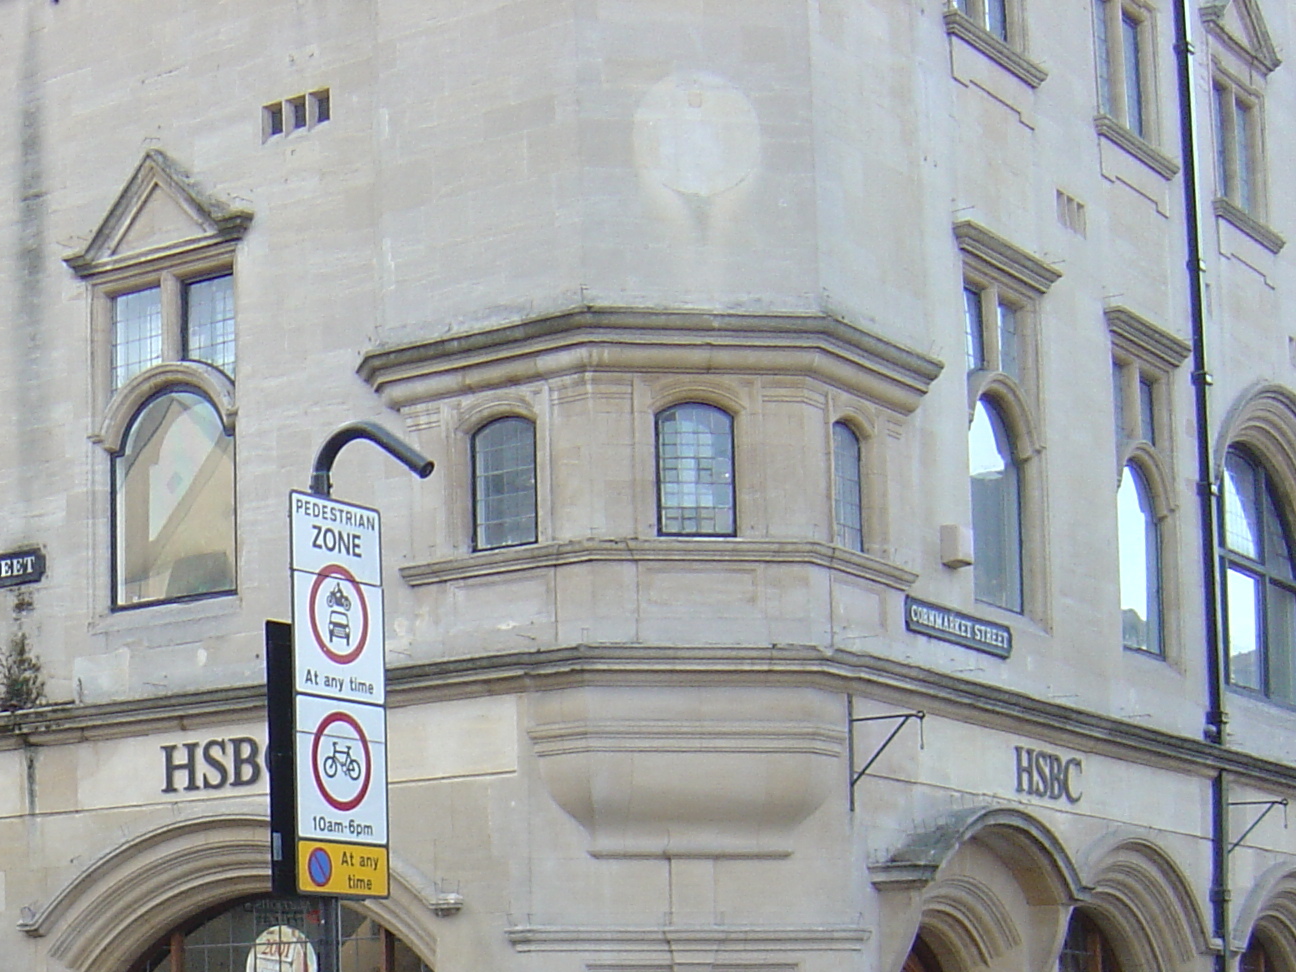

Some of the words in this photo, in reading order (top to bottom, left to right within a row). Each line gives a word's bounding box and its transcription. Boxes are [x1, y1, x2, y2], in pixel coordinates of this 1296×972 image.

[295, 498, 377, 532] PEDESTRIAN
[311, 524, 363, 558] ZONE
[910, 605, 972, 638] CORNMARKET
[974, 625, 1009, 649] STREET
[305, 668, 319, 686] At
[323, 675, 344, 694] any
[349, 675, 374, 695] time
[160, 736, 270, 793] HSB
[1014, 745, 1083, 803] HSBC
[312, 815, 374, 838] 10am-6pm
[341, 851, 354, 866] At
[357, 855, 380, 873] any
[347, 874, 373, 891] time
